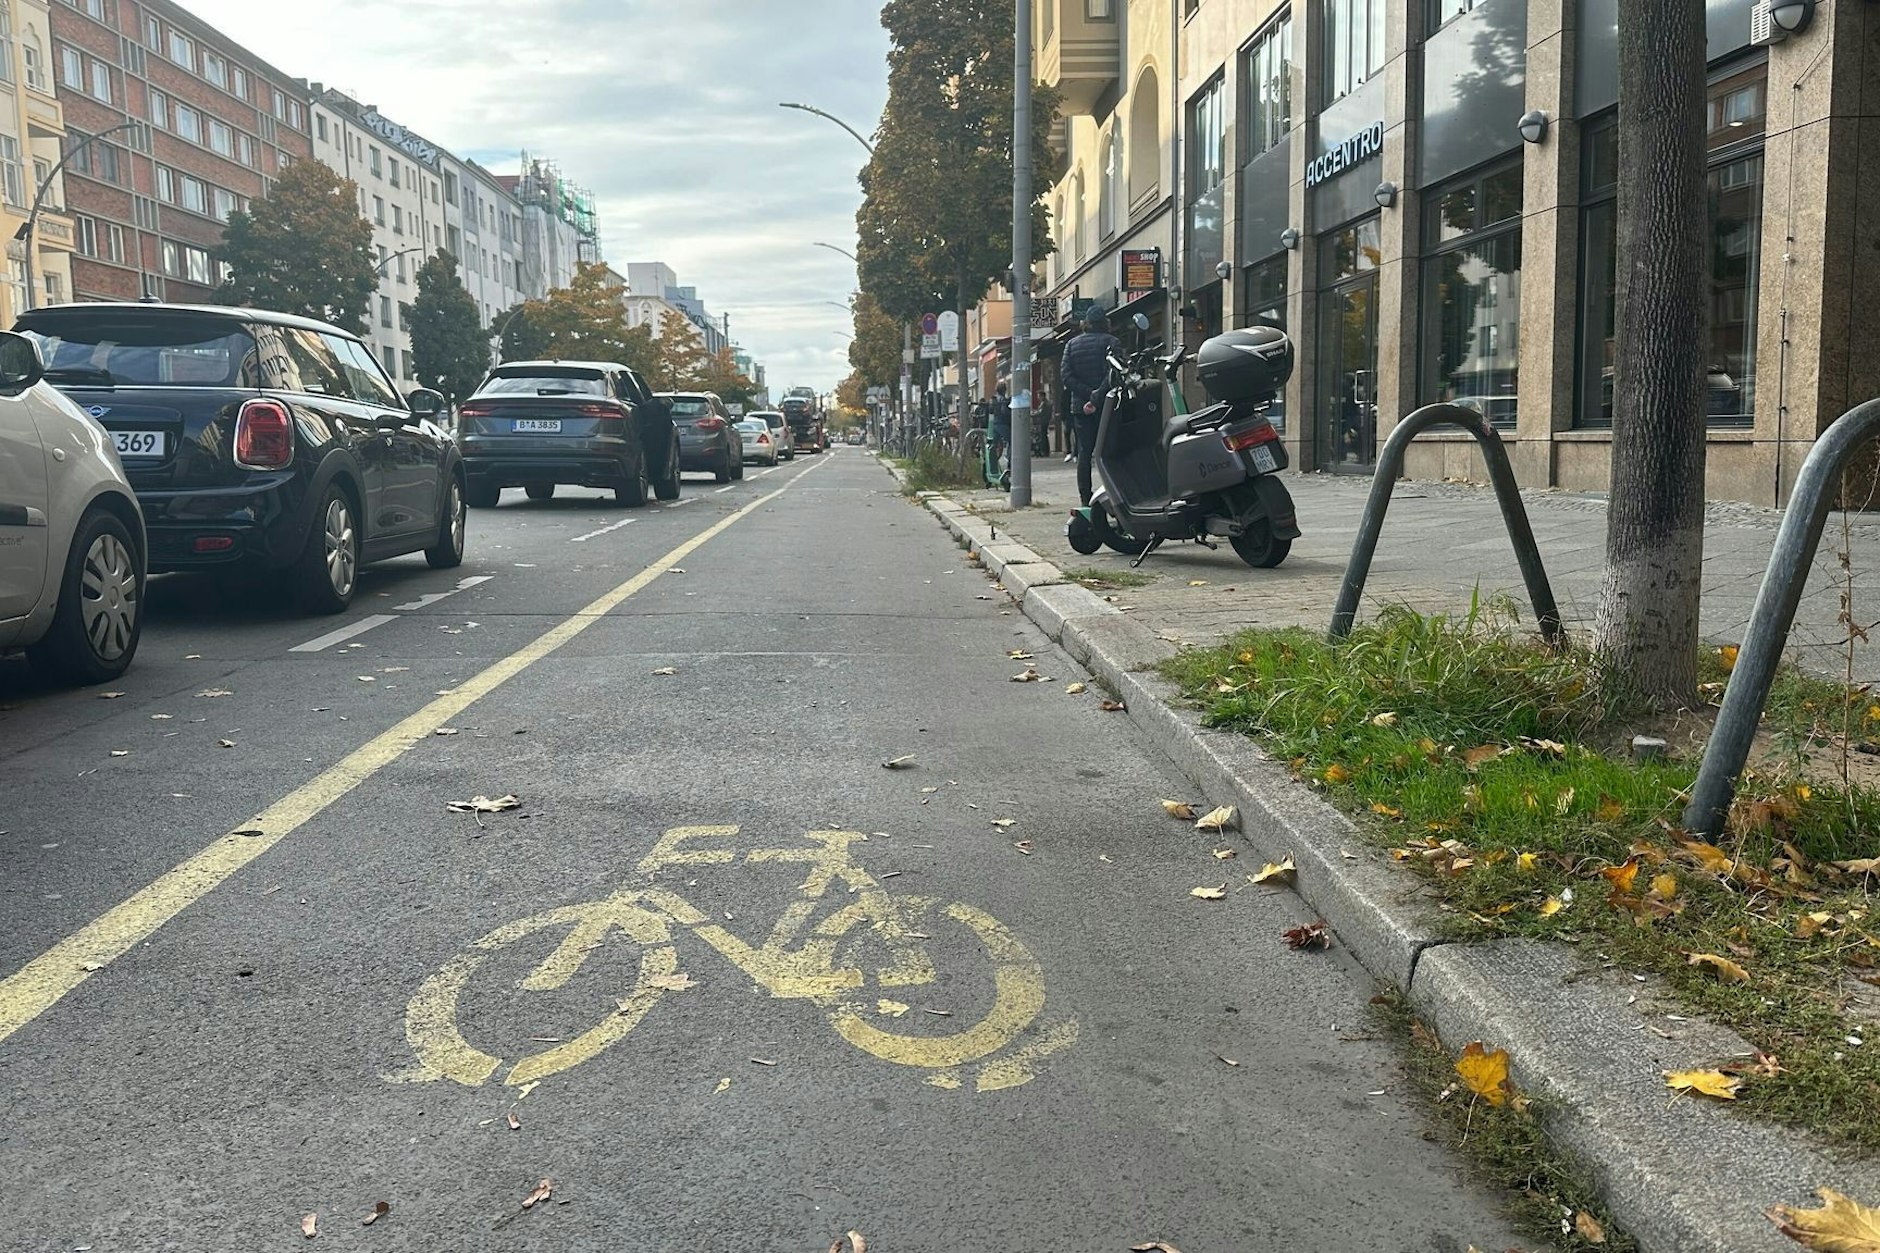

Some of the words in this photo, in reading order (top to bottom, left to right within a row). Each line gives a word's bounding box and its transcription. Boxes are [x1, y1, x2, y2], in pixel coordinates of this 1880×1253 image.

[1305, 121, 1382, 189] ACCENTRO
[537, 421, 558, 429] 3835
[117, 433, 156, 453] 369
[1251, 447, 1270, 460] 700
[1256, 458, 1274, 471] MRY
